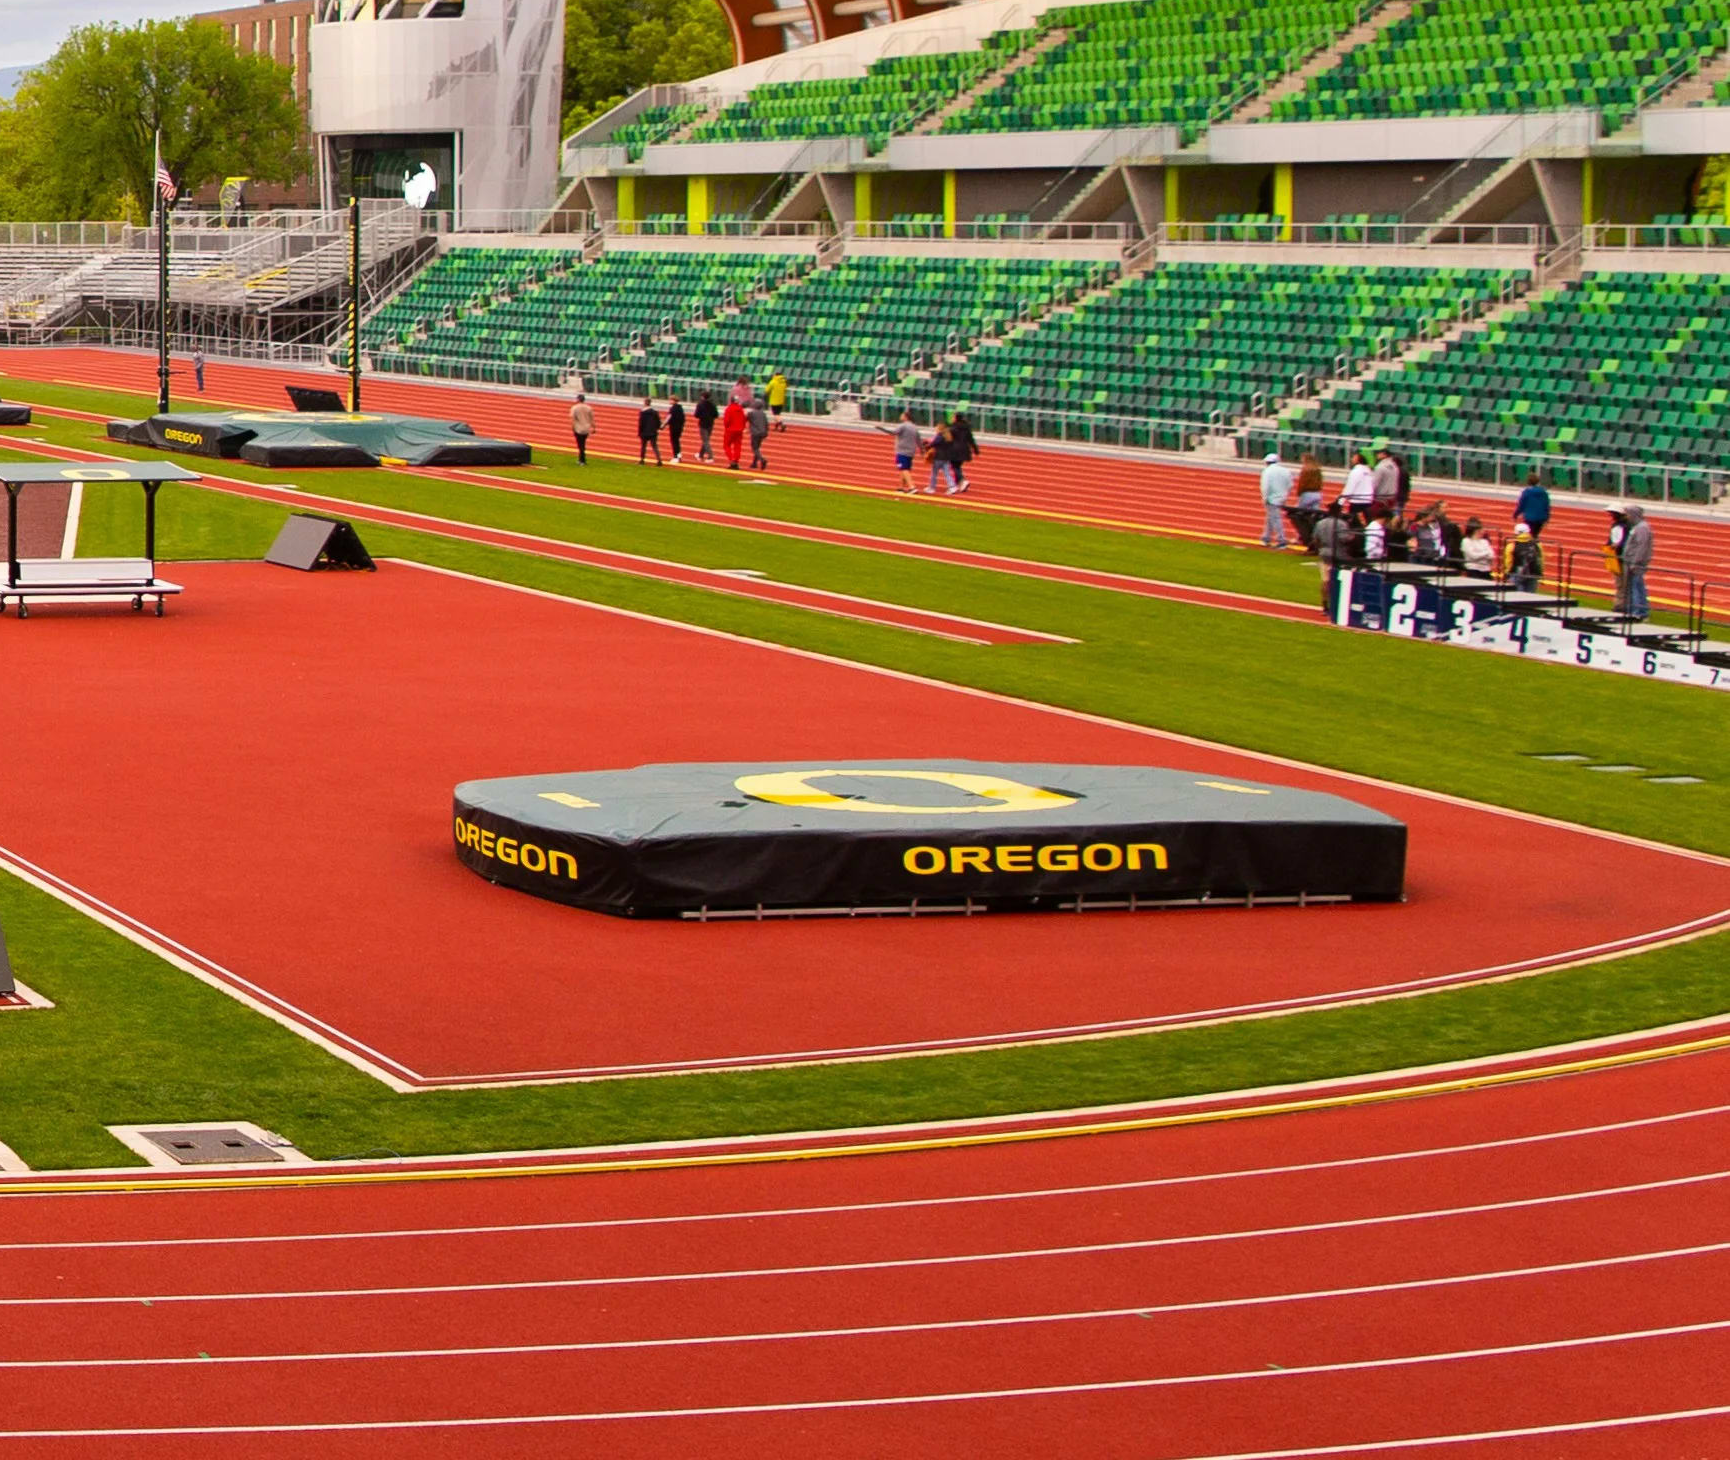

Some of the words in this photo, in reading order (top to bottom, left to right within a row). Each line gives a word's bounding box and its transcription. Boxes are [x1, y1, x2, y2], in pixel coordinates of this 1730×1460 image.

[165, 428, 203, 445] OREGON
[1337, 569, 1353, 627] 1
[1388, 583, 1418, 637] 2
[1450, 599, 1475, 645] 3
[1509, 616, 1530, 654] 4
[1576, 634, 1593, 665] 5
[1643, 651, 1657, 675] 6
[1710, 668, 1721, 685] 7
[455, 817, 578, 880] OREGON
[903, 843, 1169, 875] OREGON
